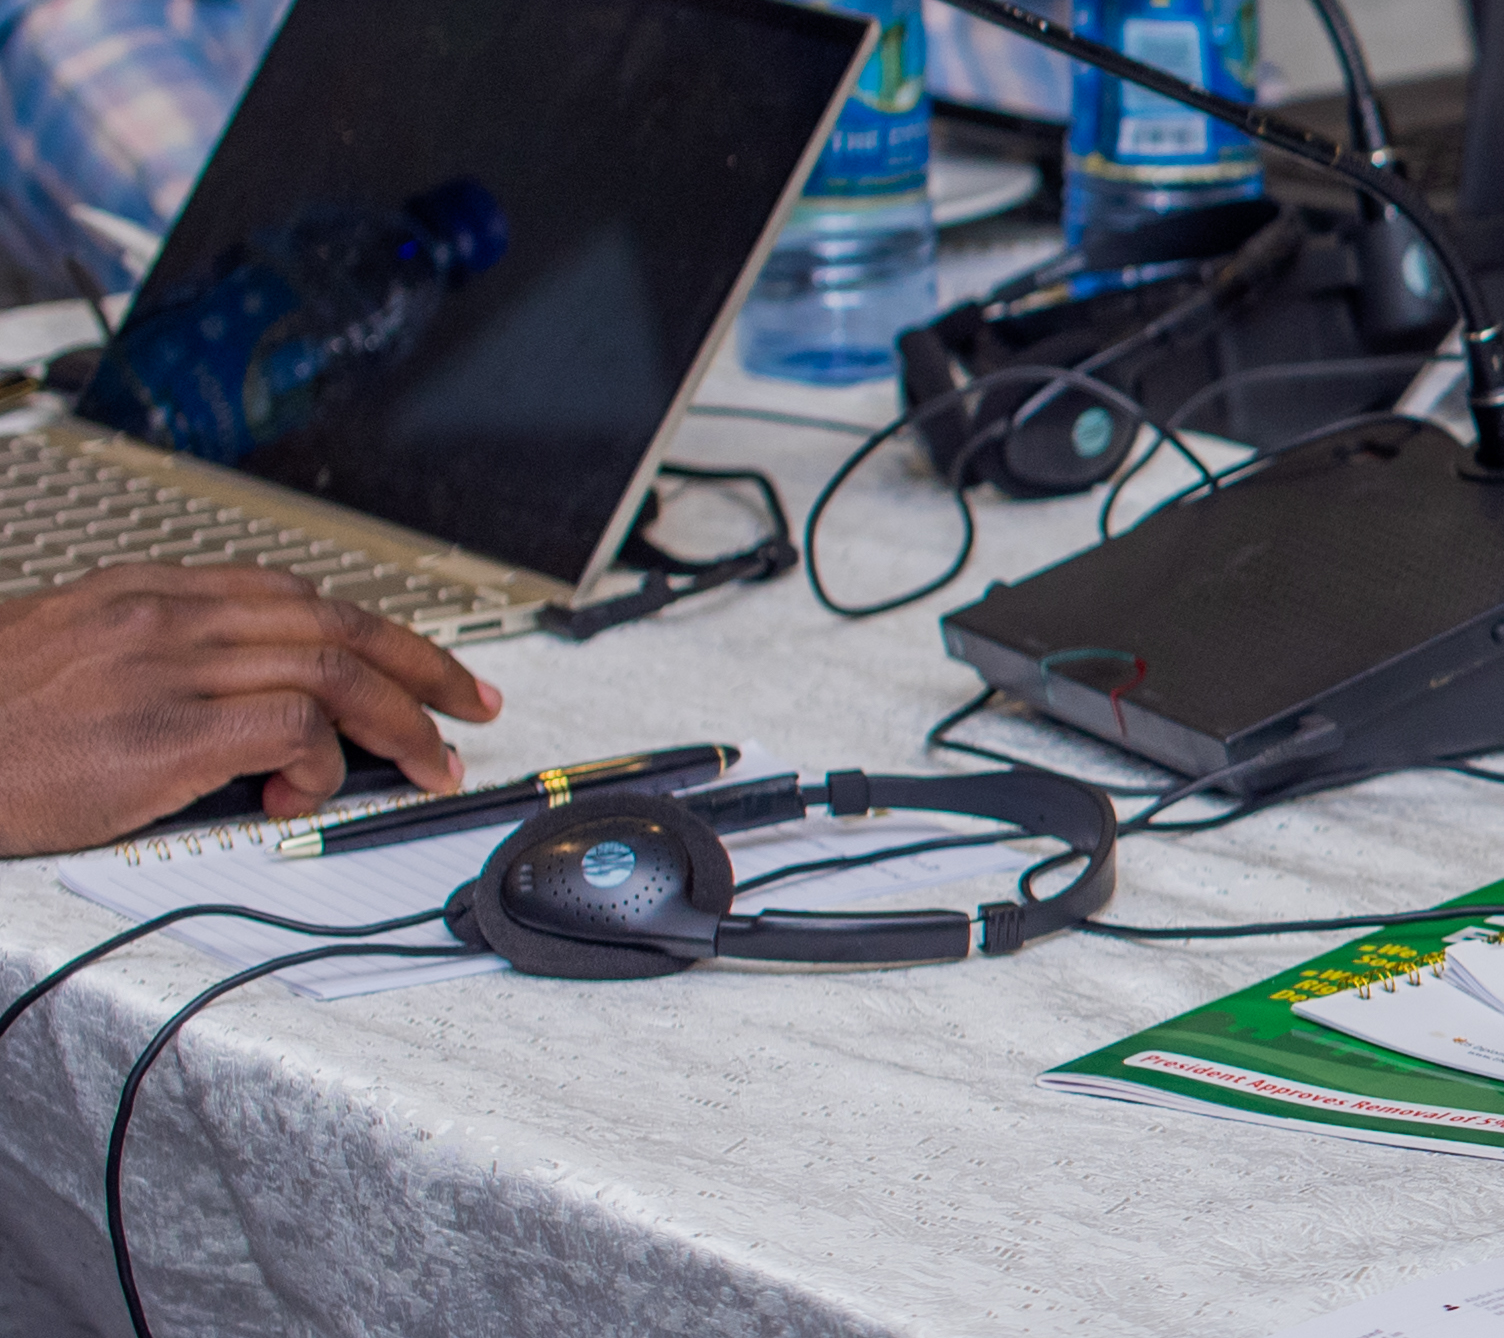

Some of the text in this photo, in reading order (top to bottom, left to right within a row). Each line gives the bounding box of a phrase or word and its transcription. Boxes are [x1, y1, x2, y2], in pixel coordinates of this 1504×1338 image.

[1139, 1054, 1249, 1084] President
[1247, 1078, 1349, 1107] Approves
[1350, 1100, 1446, 1121] Removal
[1449, 1113, 1478, 1127] of
